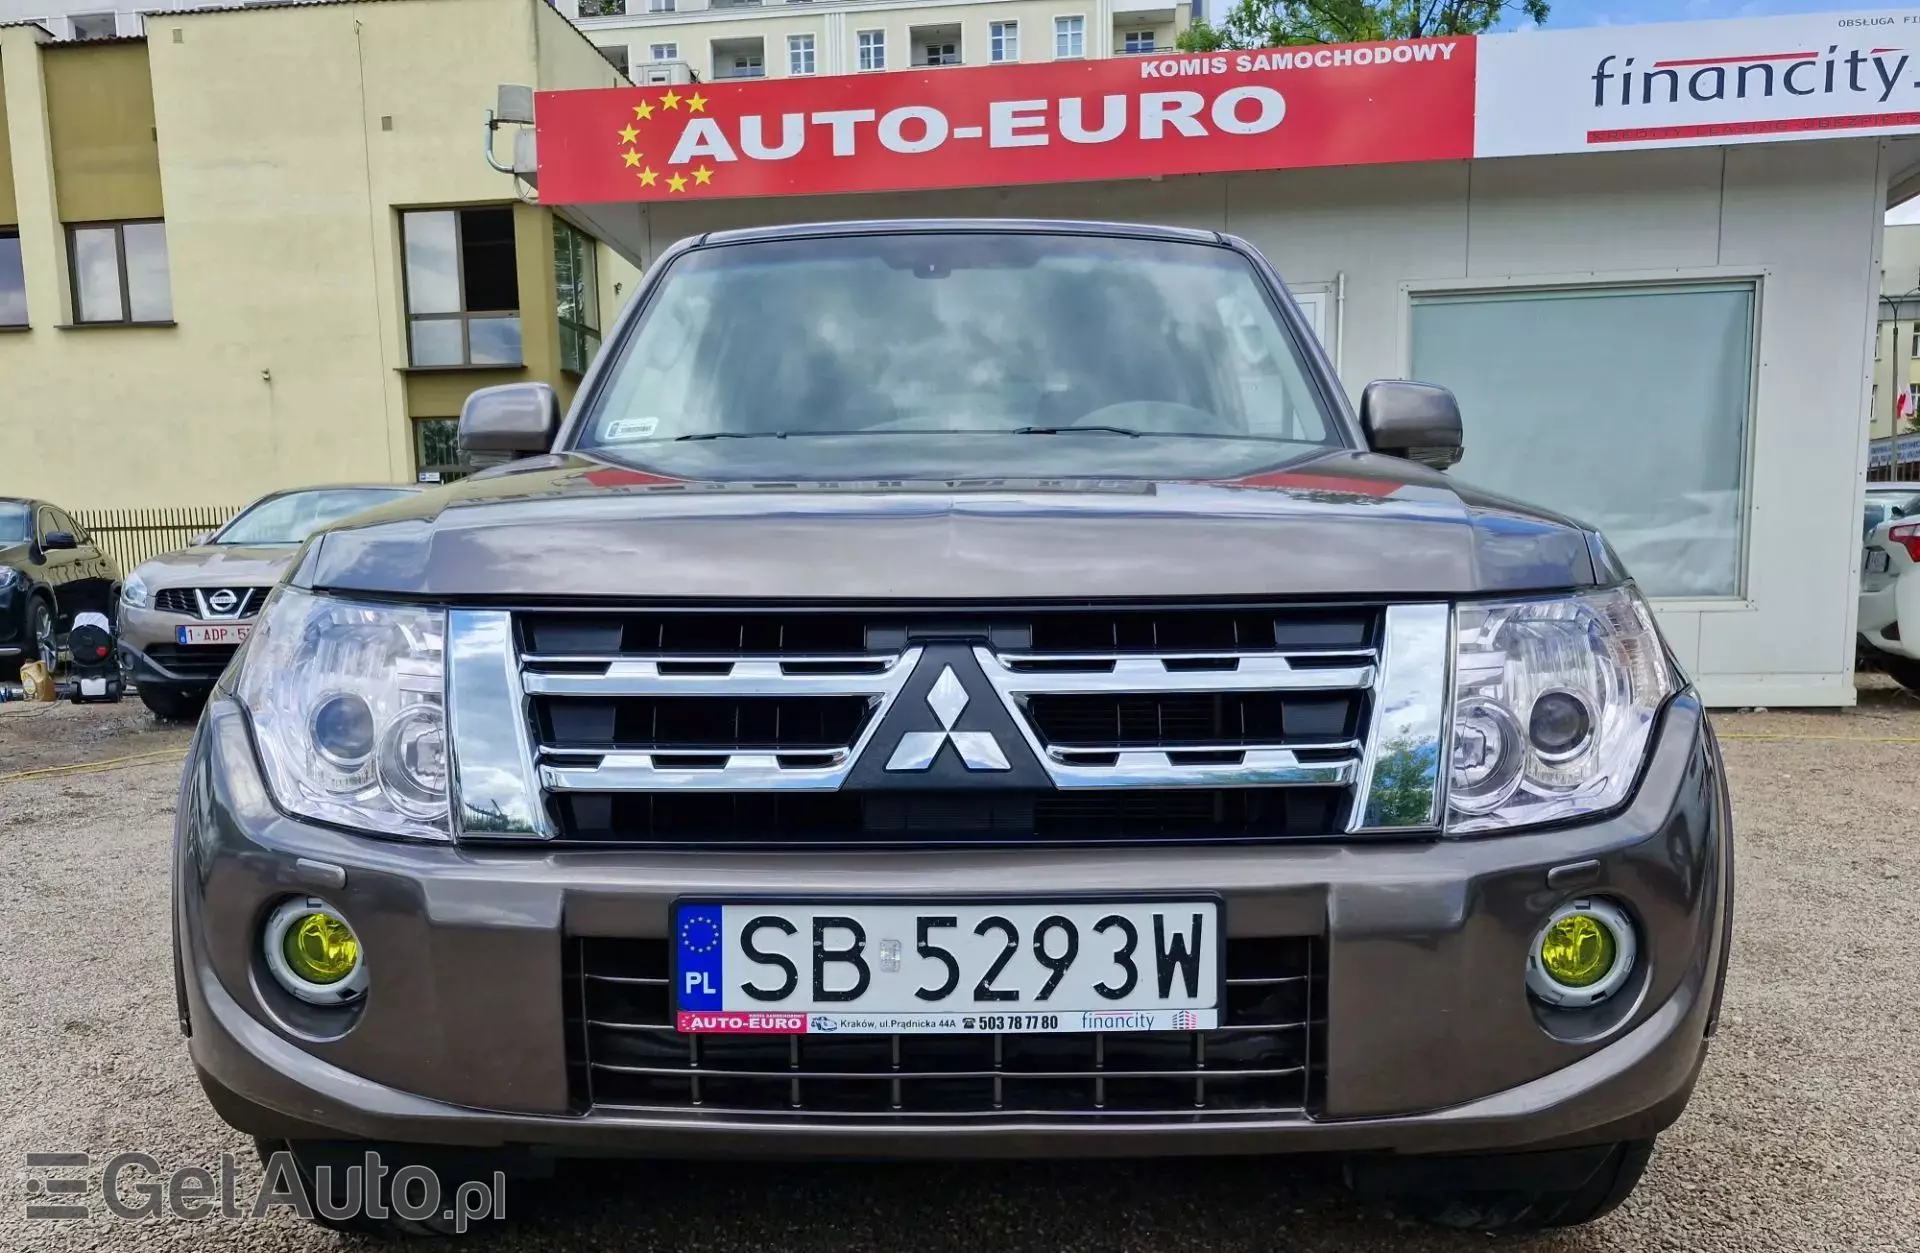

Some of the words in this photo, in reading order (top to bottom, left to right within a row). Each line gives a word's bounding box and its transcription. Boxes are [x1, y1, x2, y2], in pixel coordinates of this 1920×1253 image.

[1838, 17, 1895, 27] OBSŁUGA
[1903, 16, 1920, 24] FI
[1141, 56, 1228, 78] KOMIS
[1236, 43, 1456, 73] SAMOCHODOWY
[668, 86, 1287, 164] AUTO-EURO
[740, 915, 872, 1002] SB
[914, 913, 1203, 1002] 5293W
[685, 972, 717, 995] PL
[691, 1017, 801, 1029] AUTO-EURO
[840, 1019, 877, 1030] Kraków,
[938, 1019, 957, 1028] 44A
[978, 1015, 1004, 1030] 503
[1007, 1015, 1023, 1030] 78
[1025, 1015, 1039, 1030] 77
[1041, 1015, 1058, 1030] 80
[1082, 1011, 1155, 1031] financity
